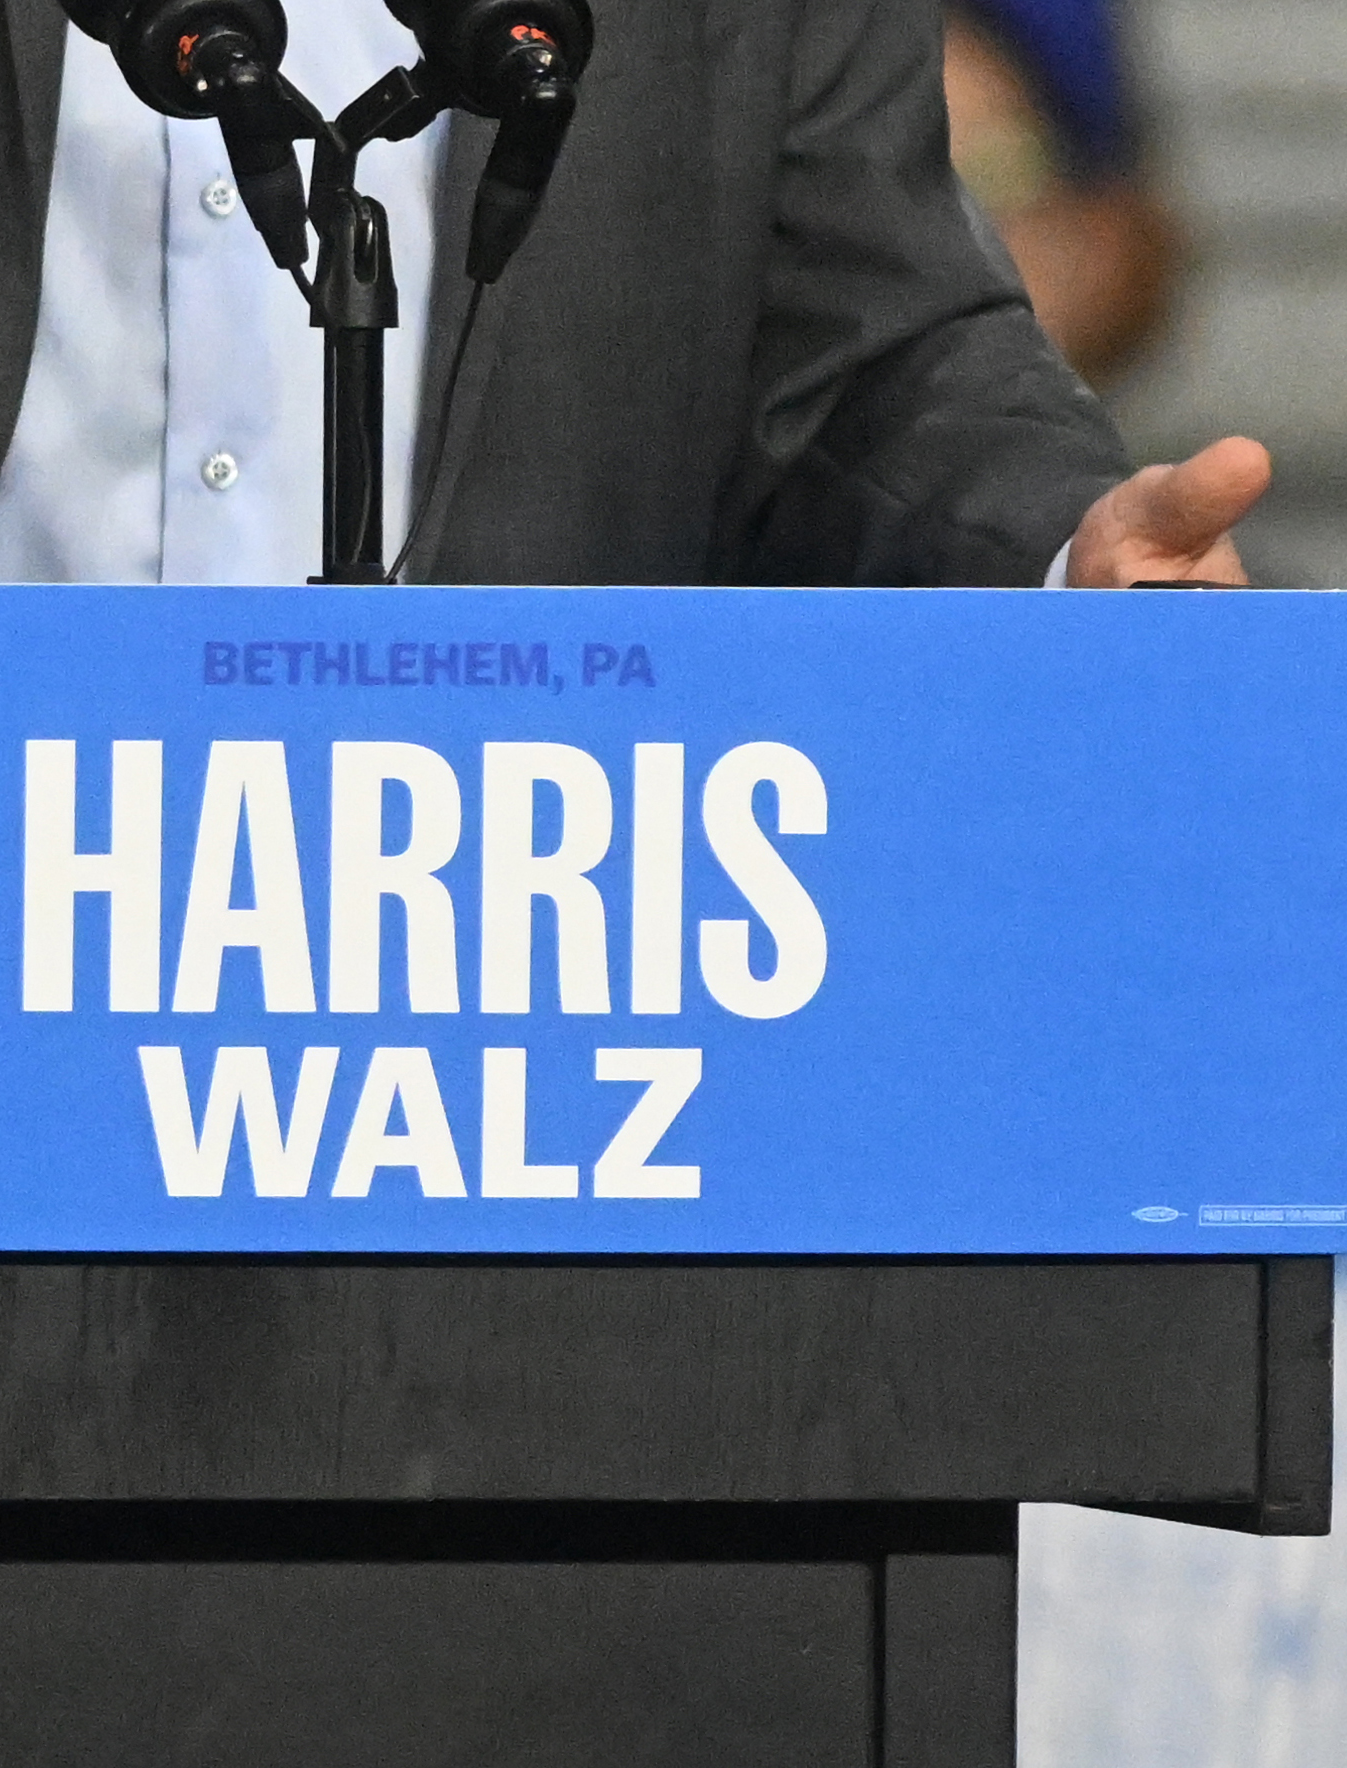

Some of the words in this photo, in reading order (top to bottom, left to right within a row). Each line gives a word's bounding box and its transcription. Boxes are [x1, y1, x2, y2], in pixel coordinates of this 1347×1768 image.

[204, 641, 564, 695] BETHLEHEM,
[582, 643, 656, 687] PA
[22, 739, 828, 1020] HARRIS
[137, 1045, 703, 1199] WALZ
